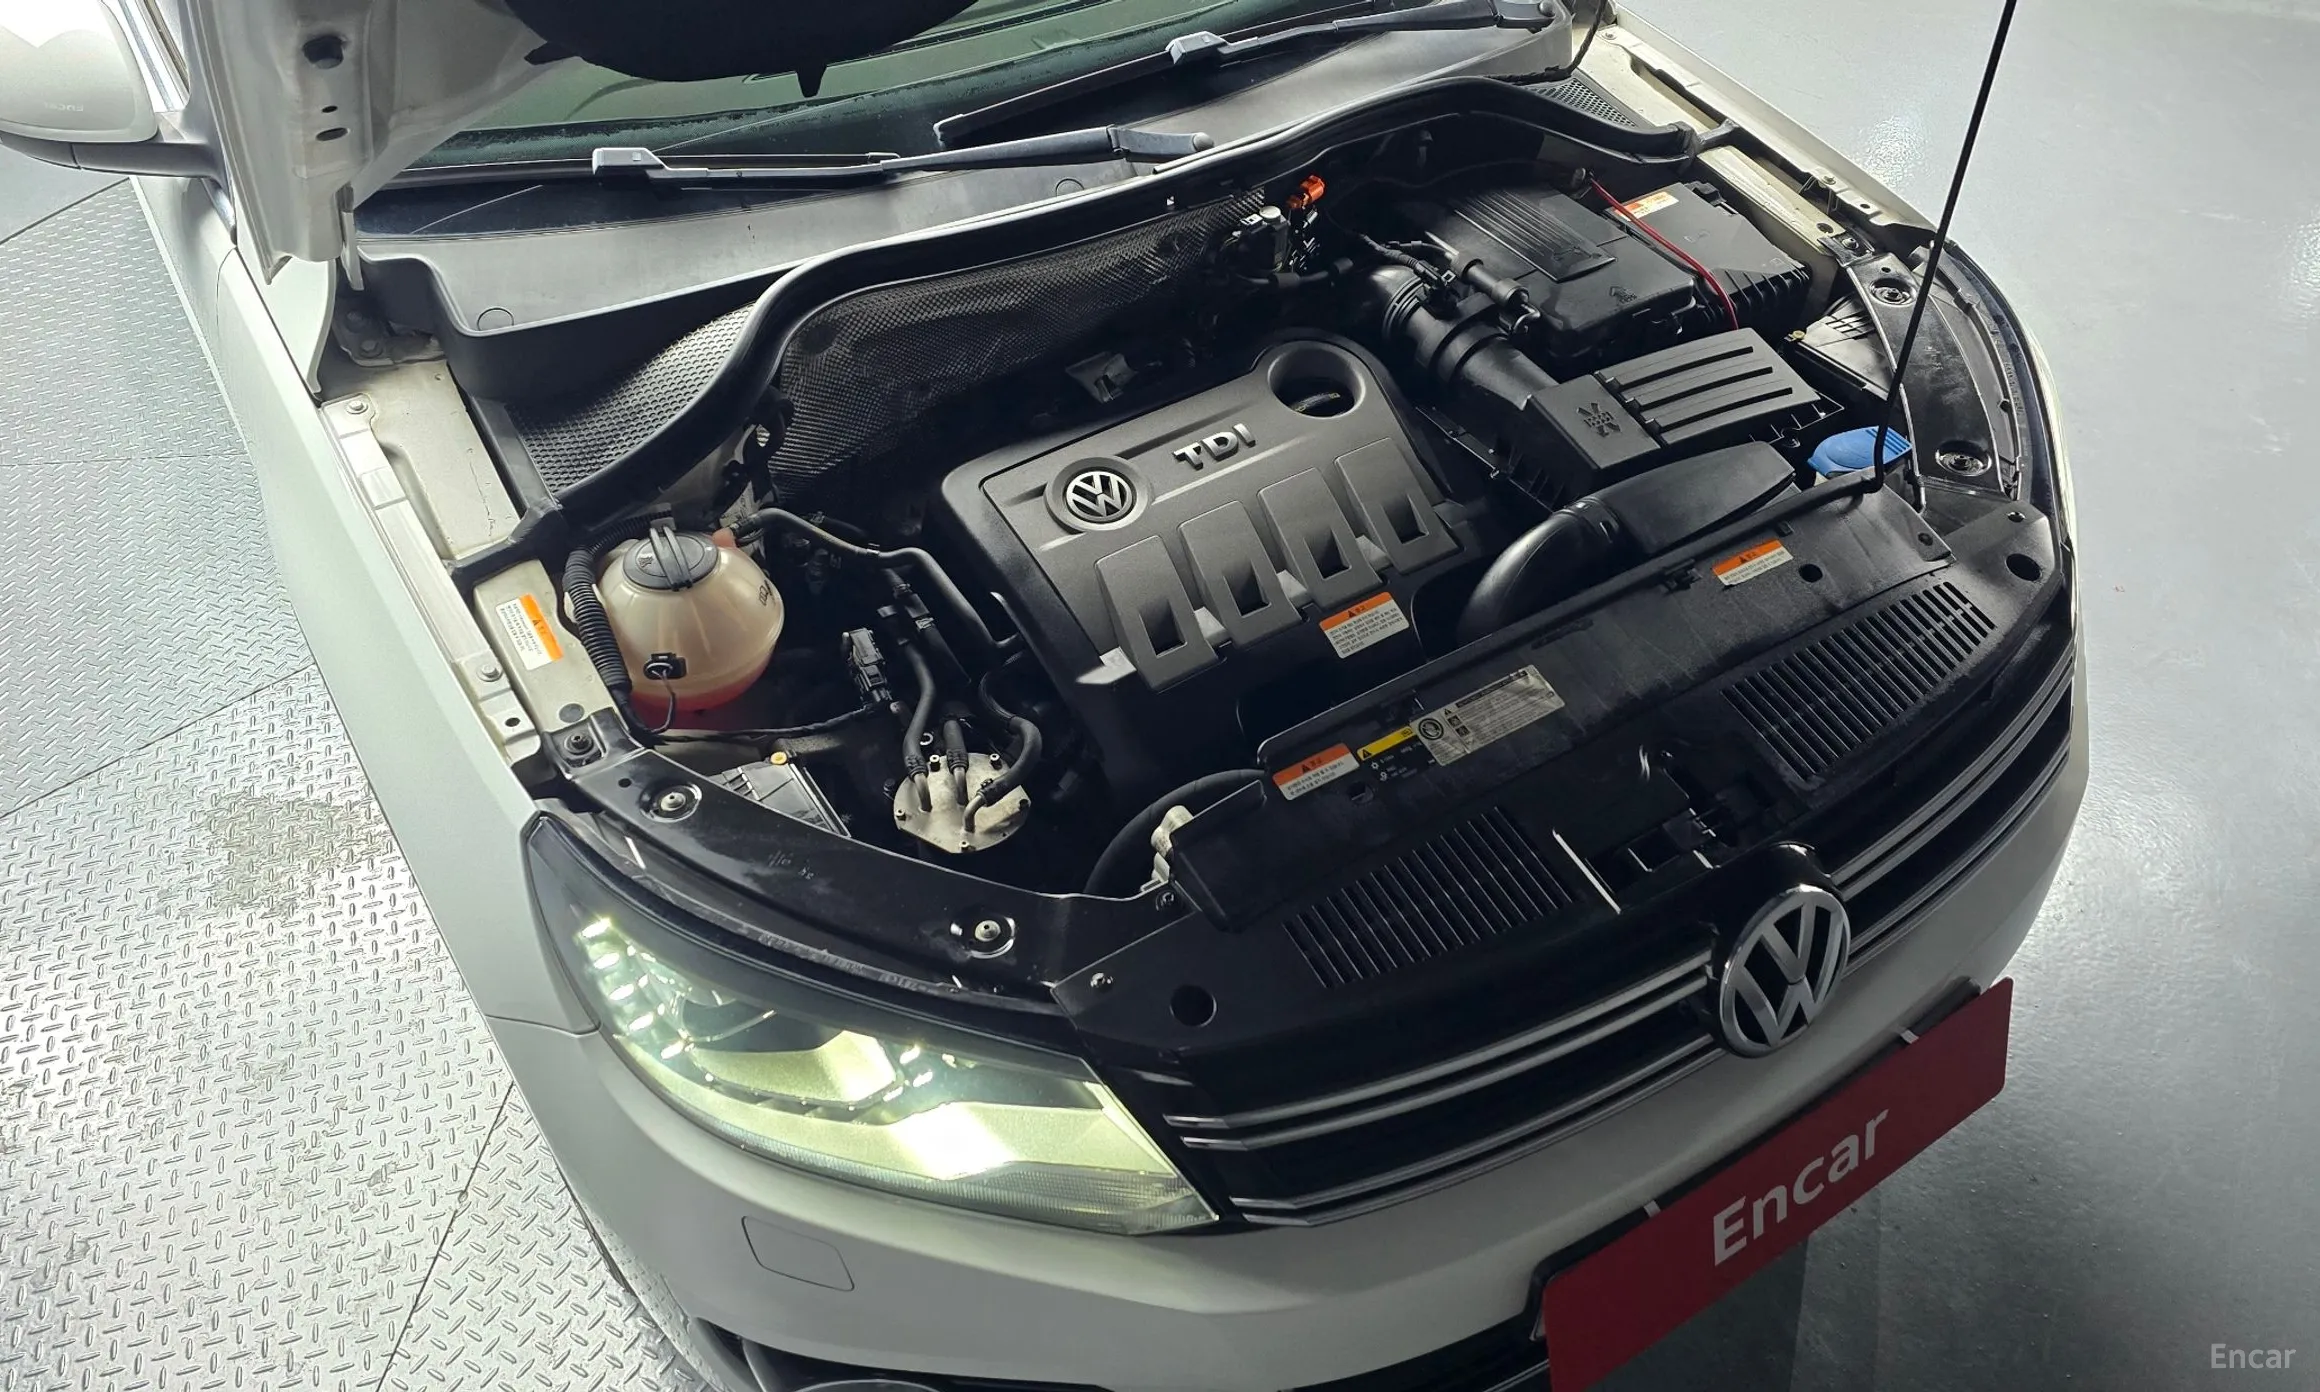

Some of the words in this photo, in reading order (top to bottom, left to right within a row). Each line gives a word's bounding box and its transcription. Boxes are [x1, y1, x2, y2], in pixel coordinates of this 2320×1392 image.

[1066, 470, 1132, 521] VW
[1173, 423, 1256, 470] TDI
[1720, 884, 1851, 1058] VW
[1713, 1109, 1889, 1267] Encar
